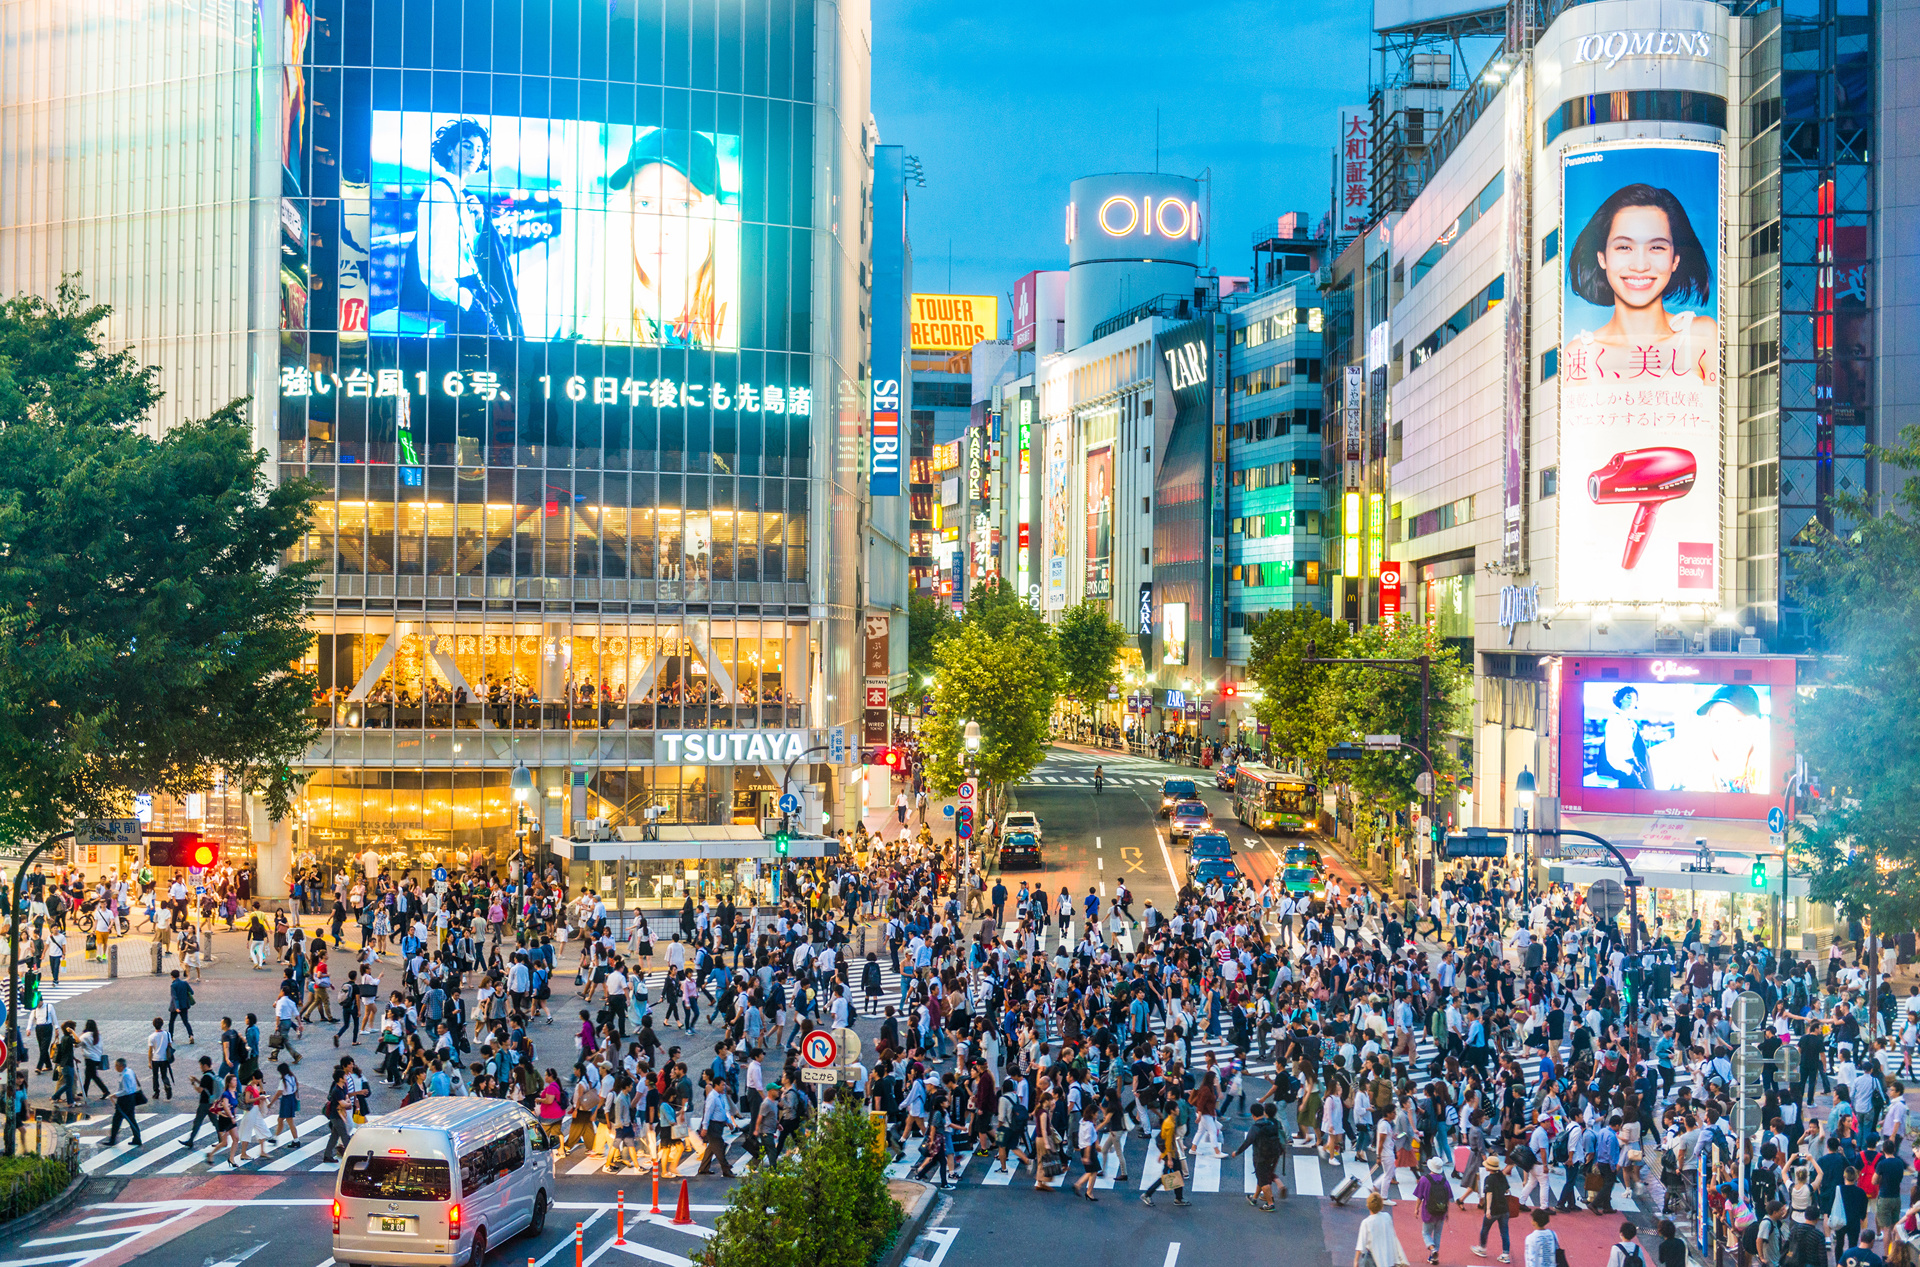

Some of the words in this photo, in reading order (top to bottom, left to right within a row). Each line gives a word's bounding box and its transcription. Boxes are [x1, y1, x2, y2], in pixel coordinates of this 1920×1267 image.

[1345, 116, 1367, 207] 大和証券
[1565, 153, 1603, 167] Panasonic
[917, 298, 973, 321] TOWER
[911, 323, 984, 346] RECORDS
[1566, 345, 1717, 382] 速く、美しく。
[873, 380, 899, 474] SEIBU
[970, 427, 980, 499] KARAOKE
[1679, 555, 1712, 565] Panasonic
[1679, 567, 1704, 578] Beauty
[1087, 581, 1097, 594] EPOS
[1098, 580, 1109, 593] CARD
[1140, 590, 1151, 634] ZARA
[401, 633, 573, 655] STARBUCKS
[592, 636, 690, 656] COFFEE
[1651, 661, 1699, 681] Glico
[869, 690, 884, 704] 本
[1167, 690, 1184, 707] ZARA
[662, 733, 805, 761] TSUTAYA
[329, 820, 380, 829] STARBUCKS
[804, 1072, 834, 1081] ここから
